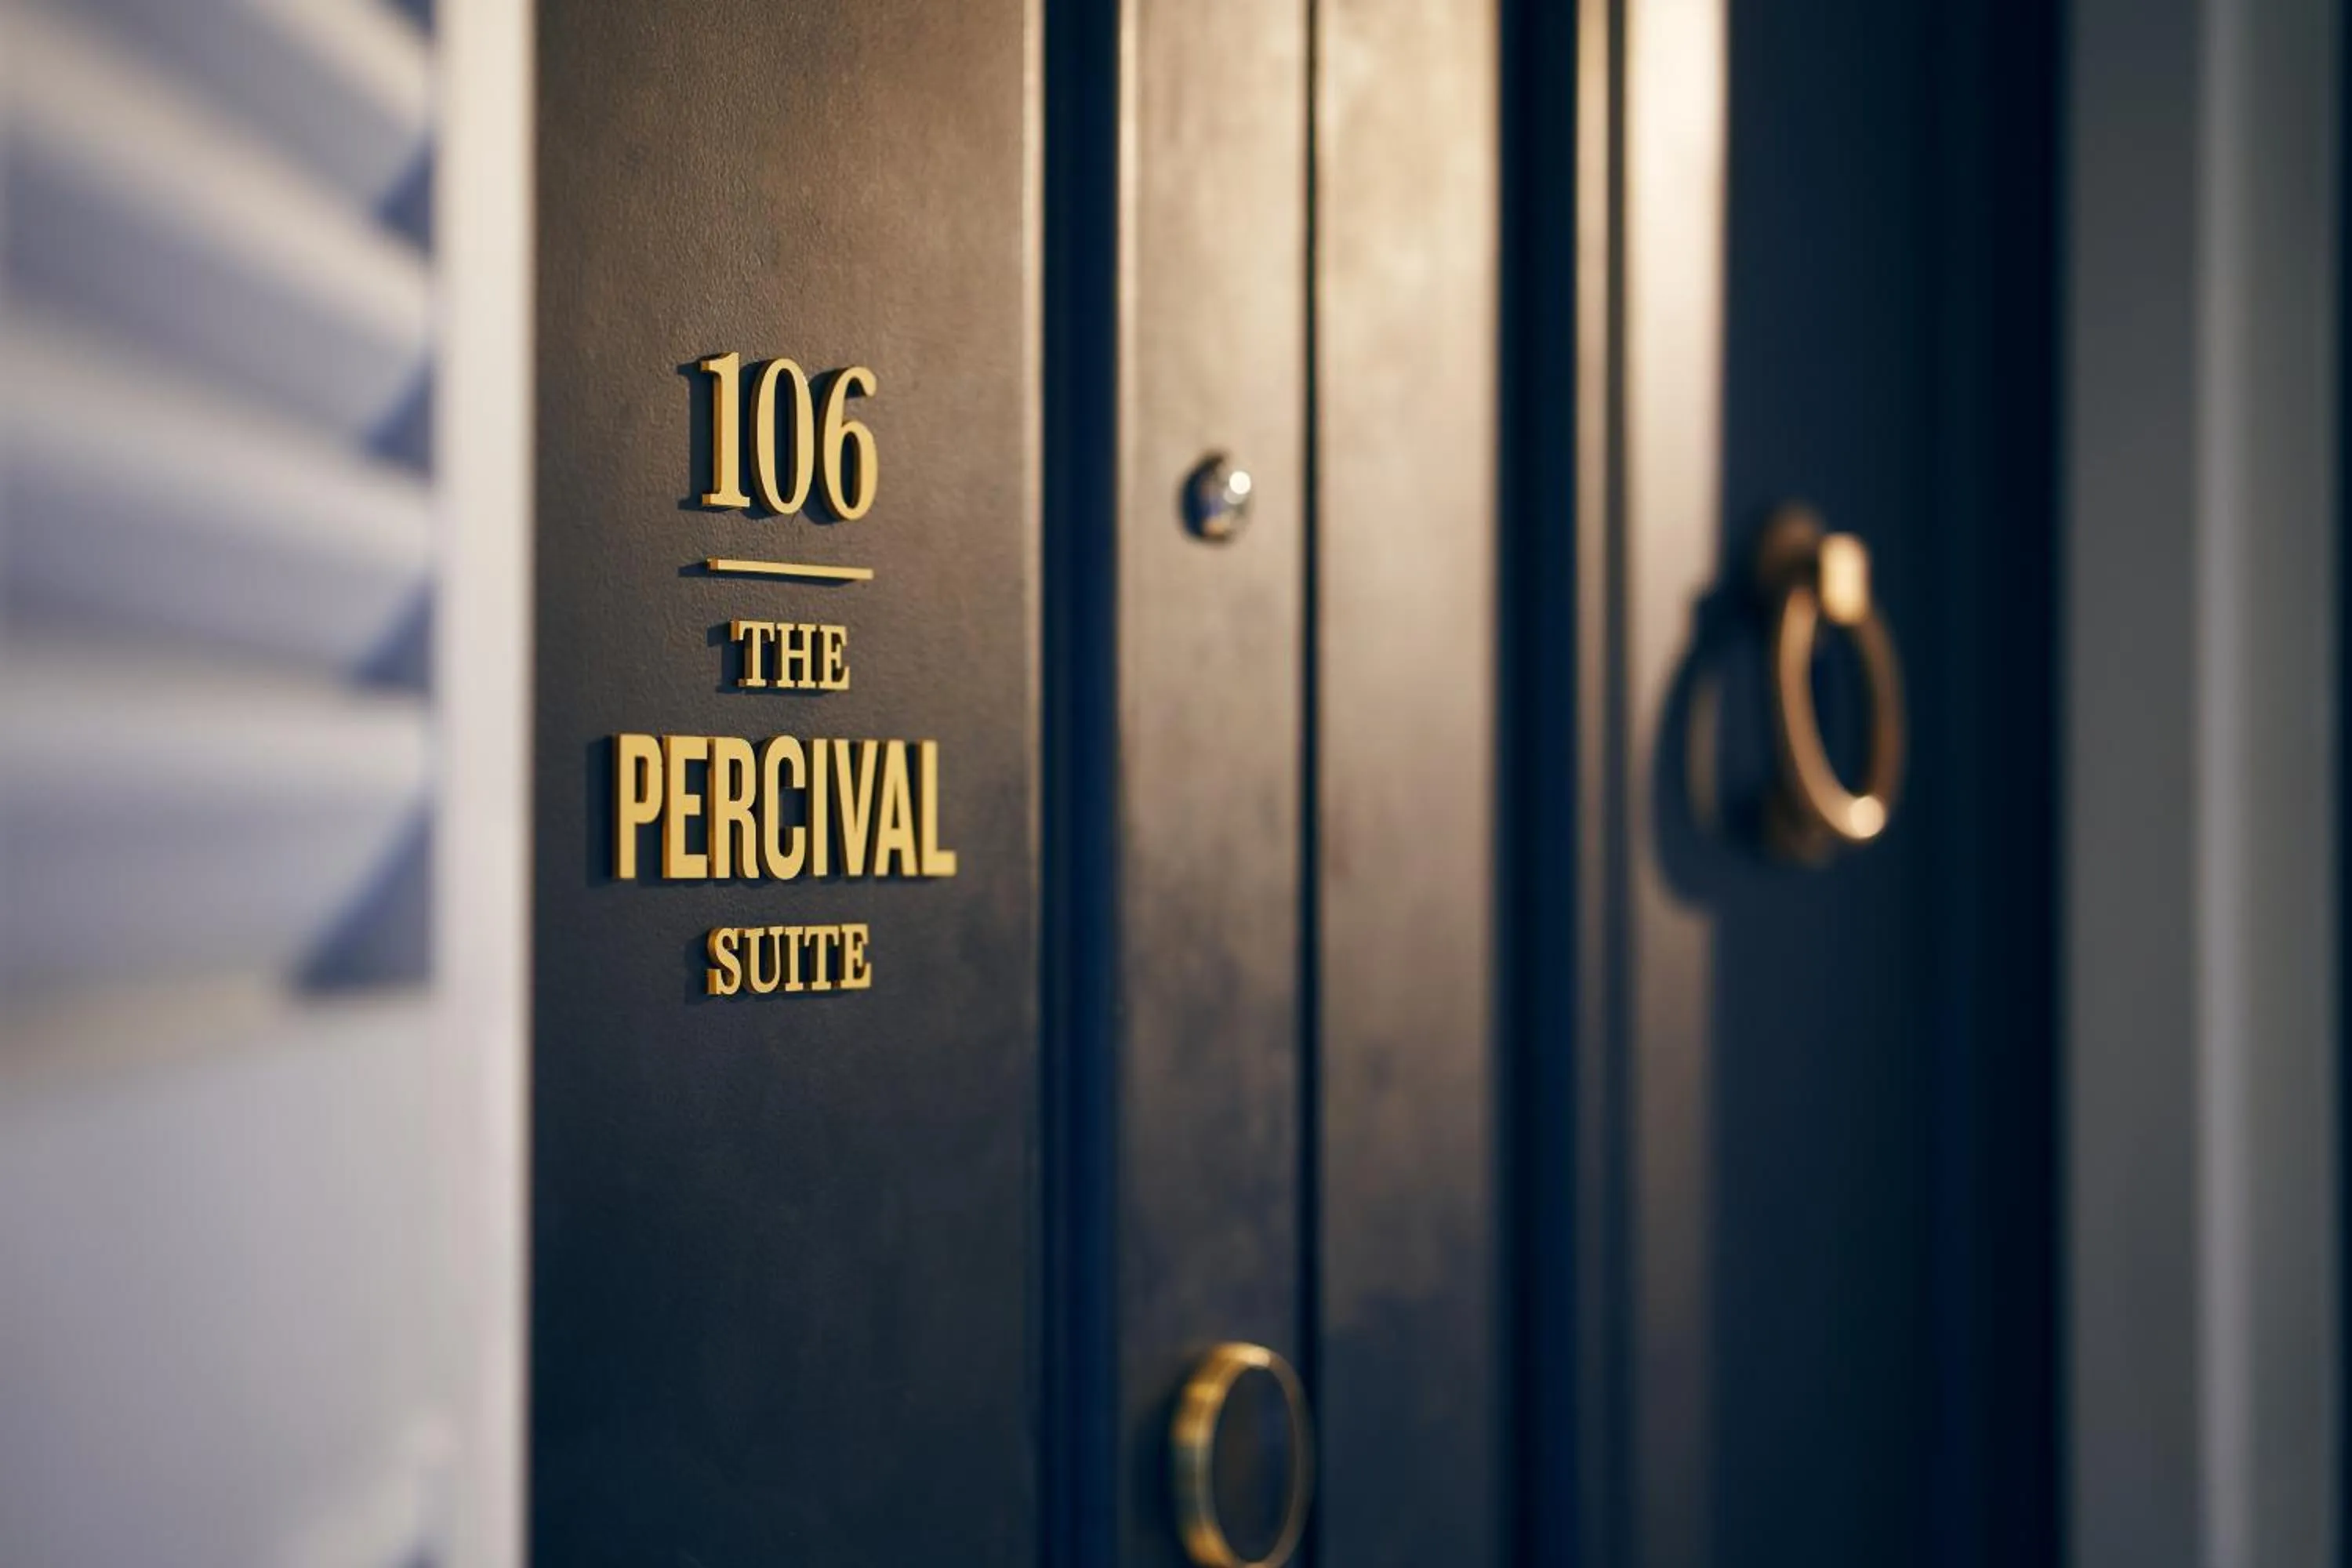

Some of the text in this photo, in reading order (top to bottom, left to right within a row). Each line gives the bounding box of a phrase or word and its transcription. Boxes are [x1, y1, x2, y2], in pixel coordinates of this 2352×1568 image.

[700, 351, 879, 522] 106
[730, 619, 851, 690] THE
[614, 734, 957, 880] PERCIVAL
[706, 923, 873, 996] SUITE
